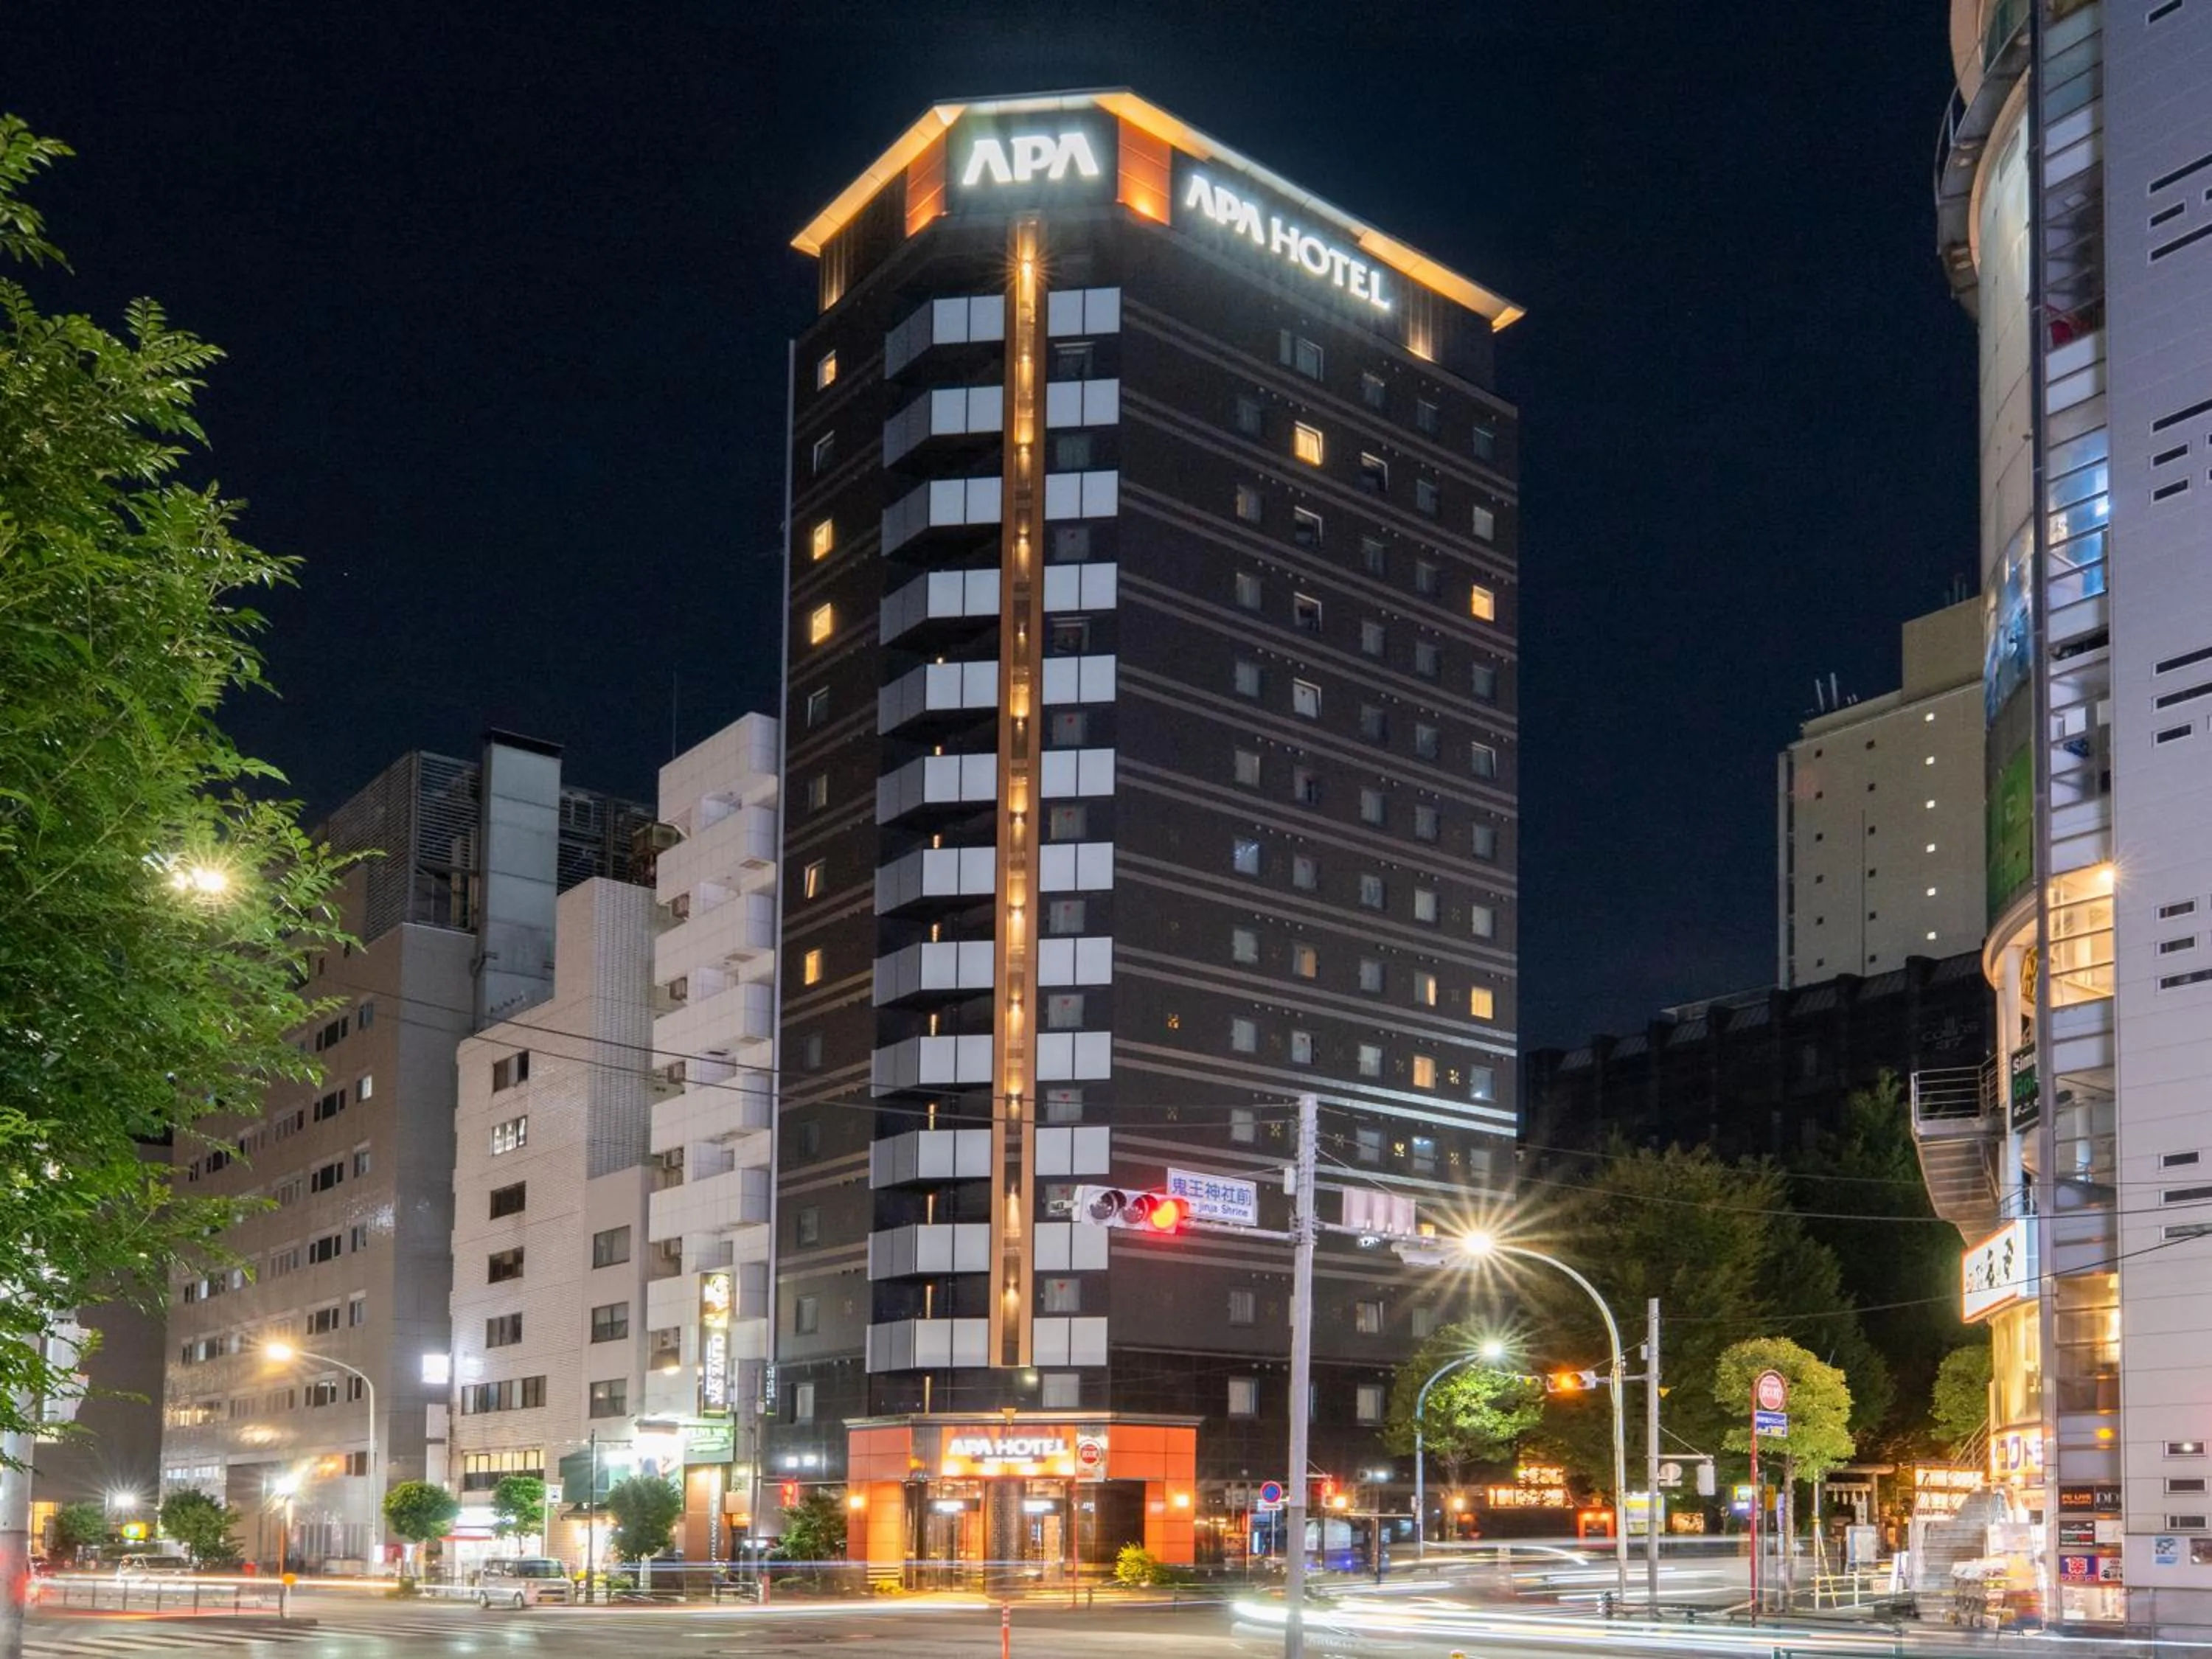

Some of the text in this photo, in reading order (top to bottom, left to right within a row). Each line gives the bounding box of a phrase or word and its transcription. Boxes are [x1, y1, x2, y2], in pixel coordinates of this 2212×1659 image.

[962, 131, 1099, 185] APA
[1186, 174, 1391, 310] APA HOTEL
[1172, 1178, 1251, 1206] 鬼王神社前
[1221, 1204, 1248, 1217] Shrine
[948, 1439, 992, 1455] APA
[996, 1439, 1068, 1455] HOTEL
